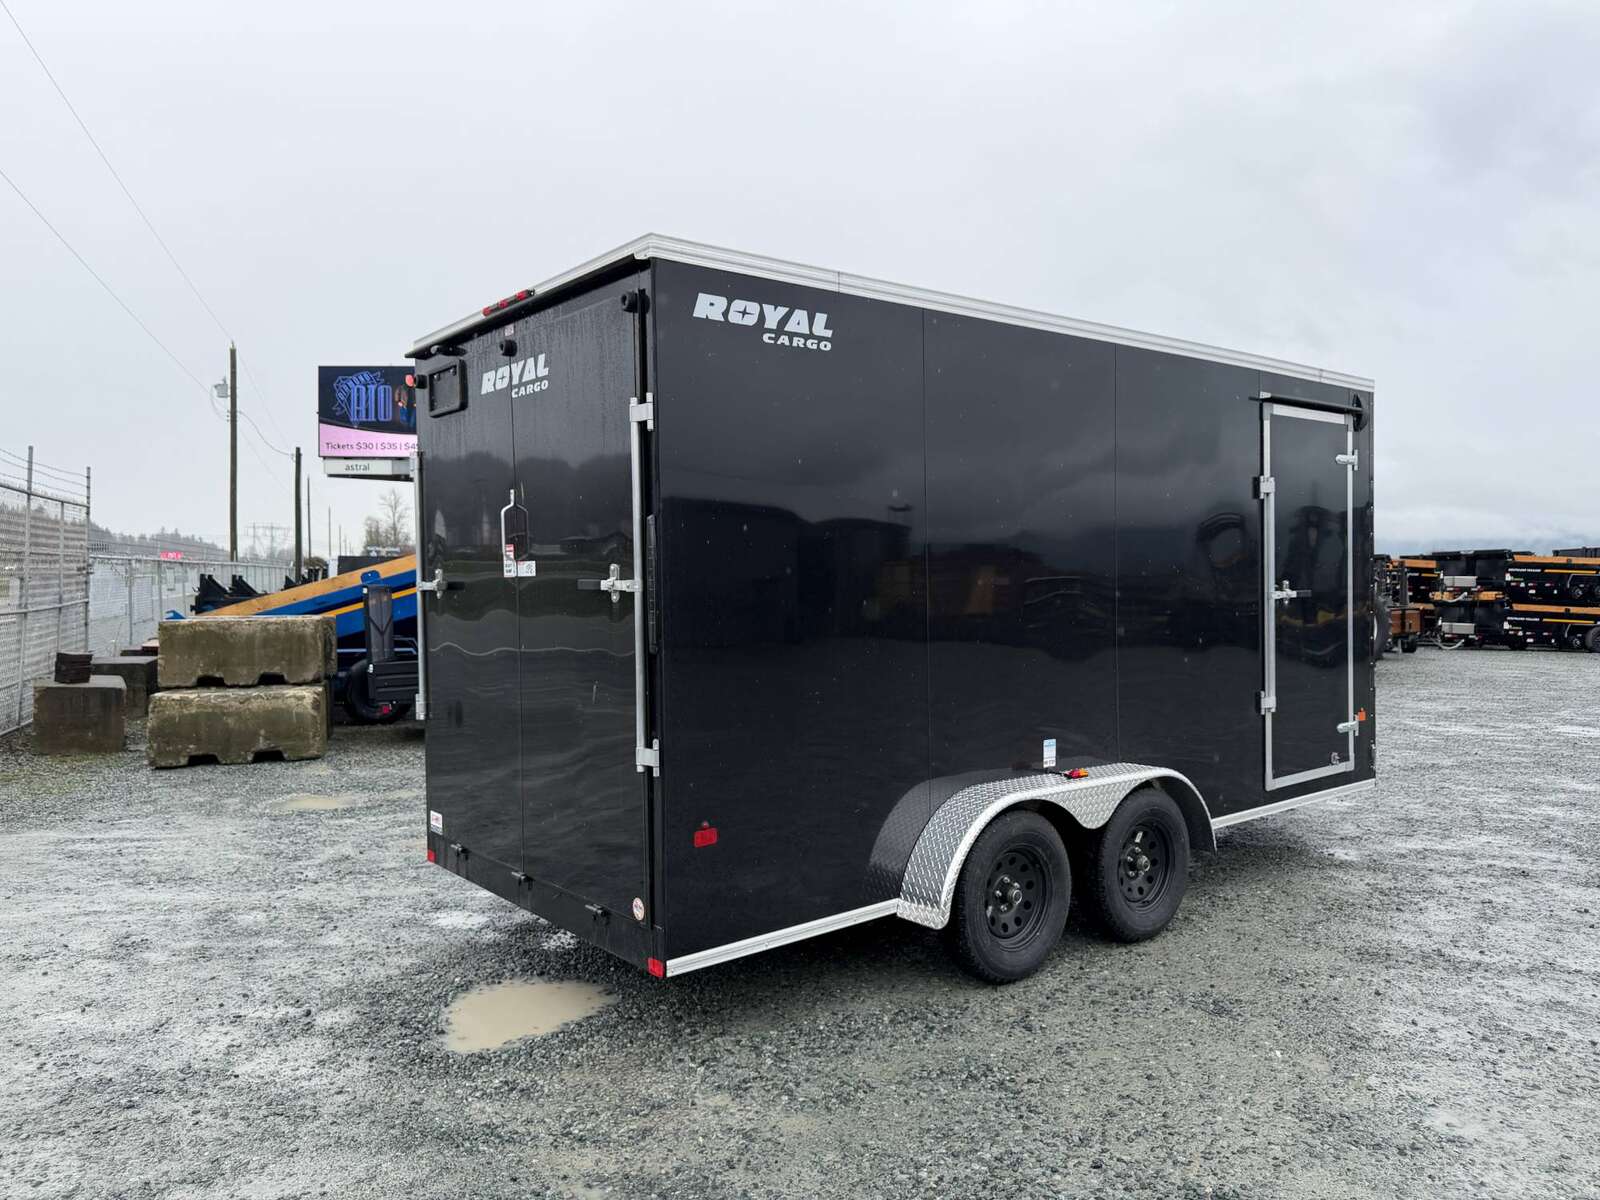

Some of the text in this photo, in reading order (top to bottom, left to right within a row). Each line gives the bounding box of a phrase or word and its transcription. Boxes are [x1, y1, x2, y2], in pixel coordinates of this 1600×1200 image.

[692, 292, 834, 338] ROYAL
[762, 333, 832, 351] CARGO
[480, 352, 550, 396] ROYAL
[511, 379, 549, 399] CARGO
[326, 442, 354, 450] Tickets
[356, 442, 374, 450] $30
[380, 442, 398, 450] $35
[344, 463, 370, 472] astral
